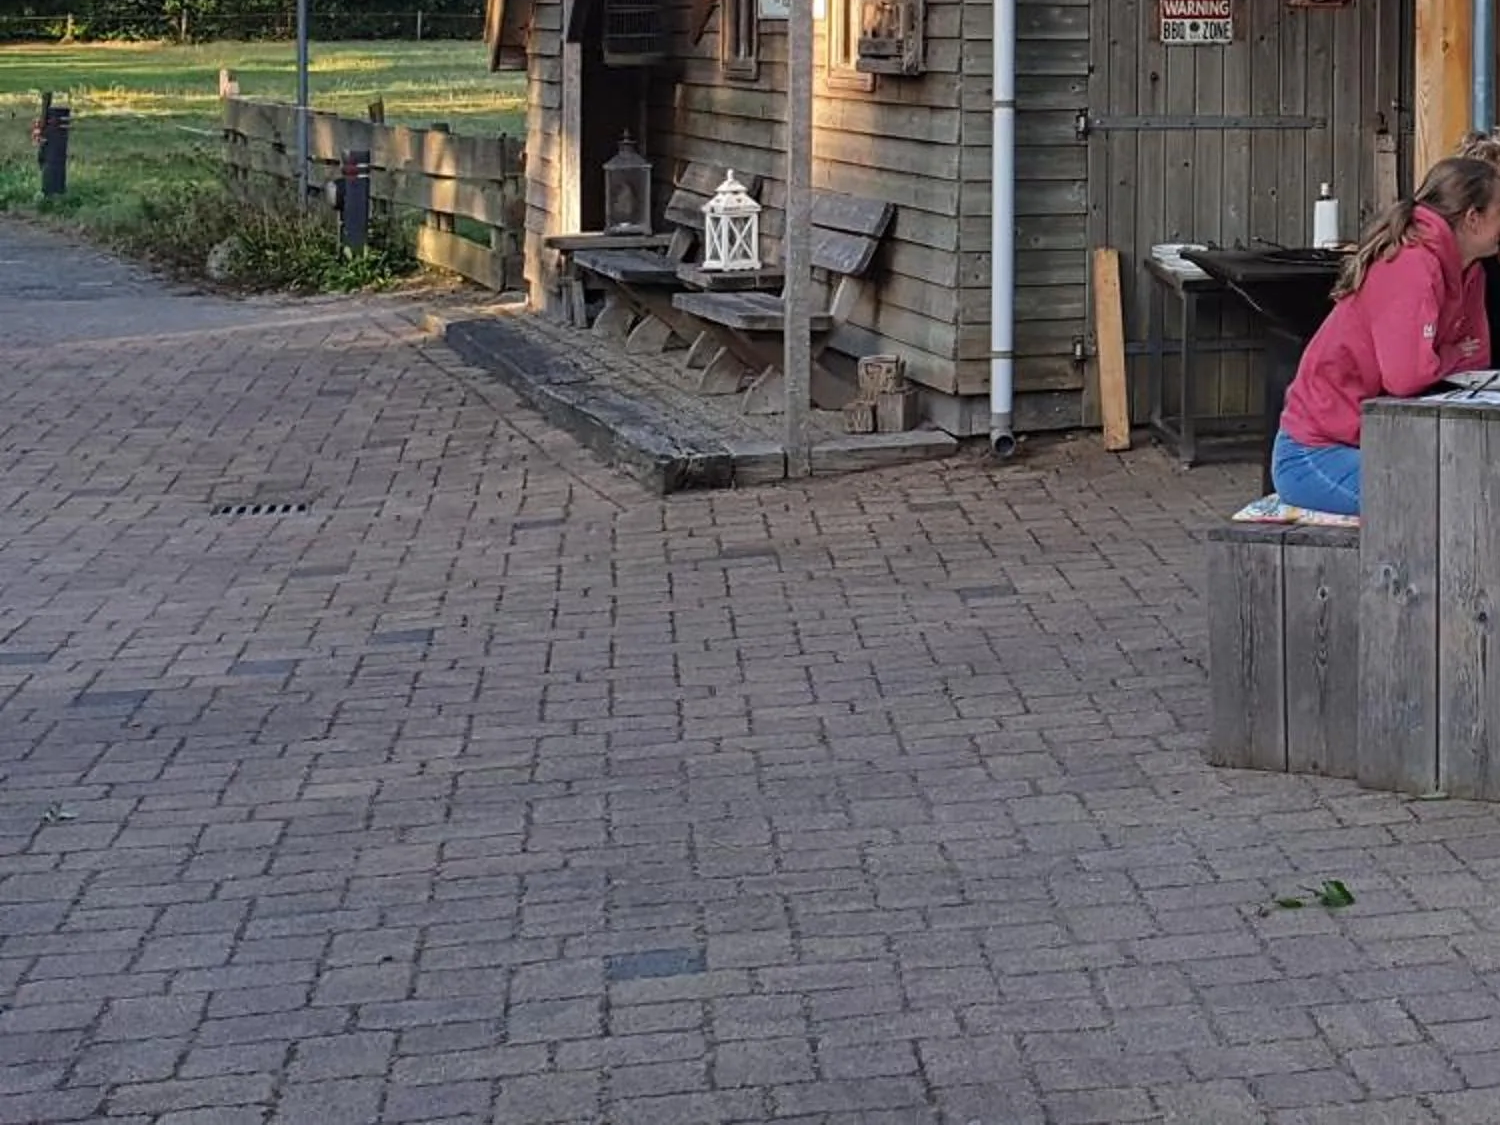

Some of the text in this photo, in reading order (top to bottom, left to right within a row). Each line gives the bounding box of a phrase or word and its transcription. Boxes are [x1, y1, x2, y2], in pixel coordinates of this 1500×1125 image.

[1163, 0, 1229, 16] WARNING
[1163, 21, 1230, 40] BBQ ZONE
